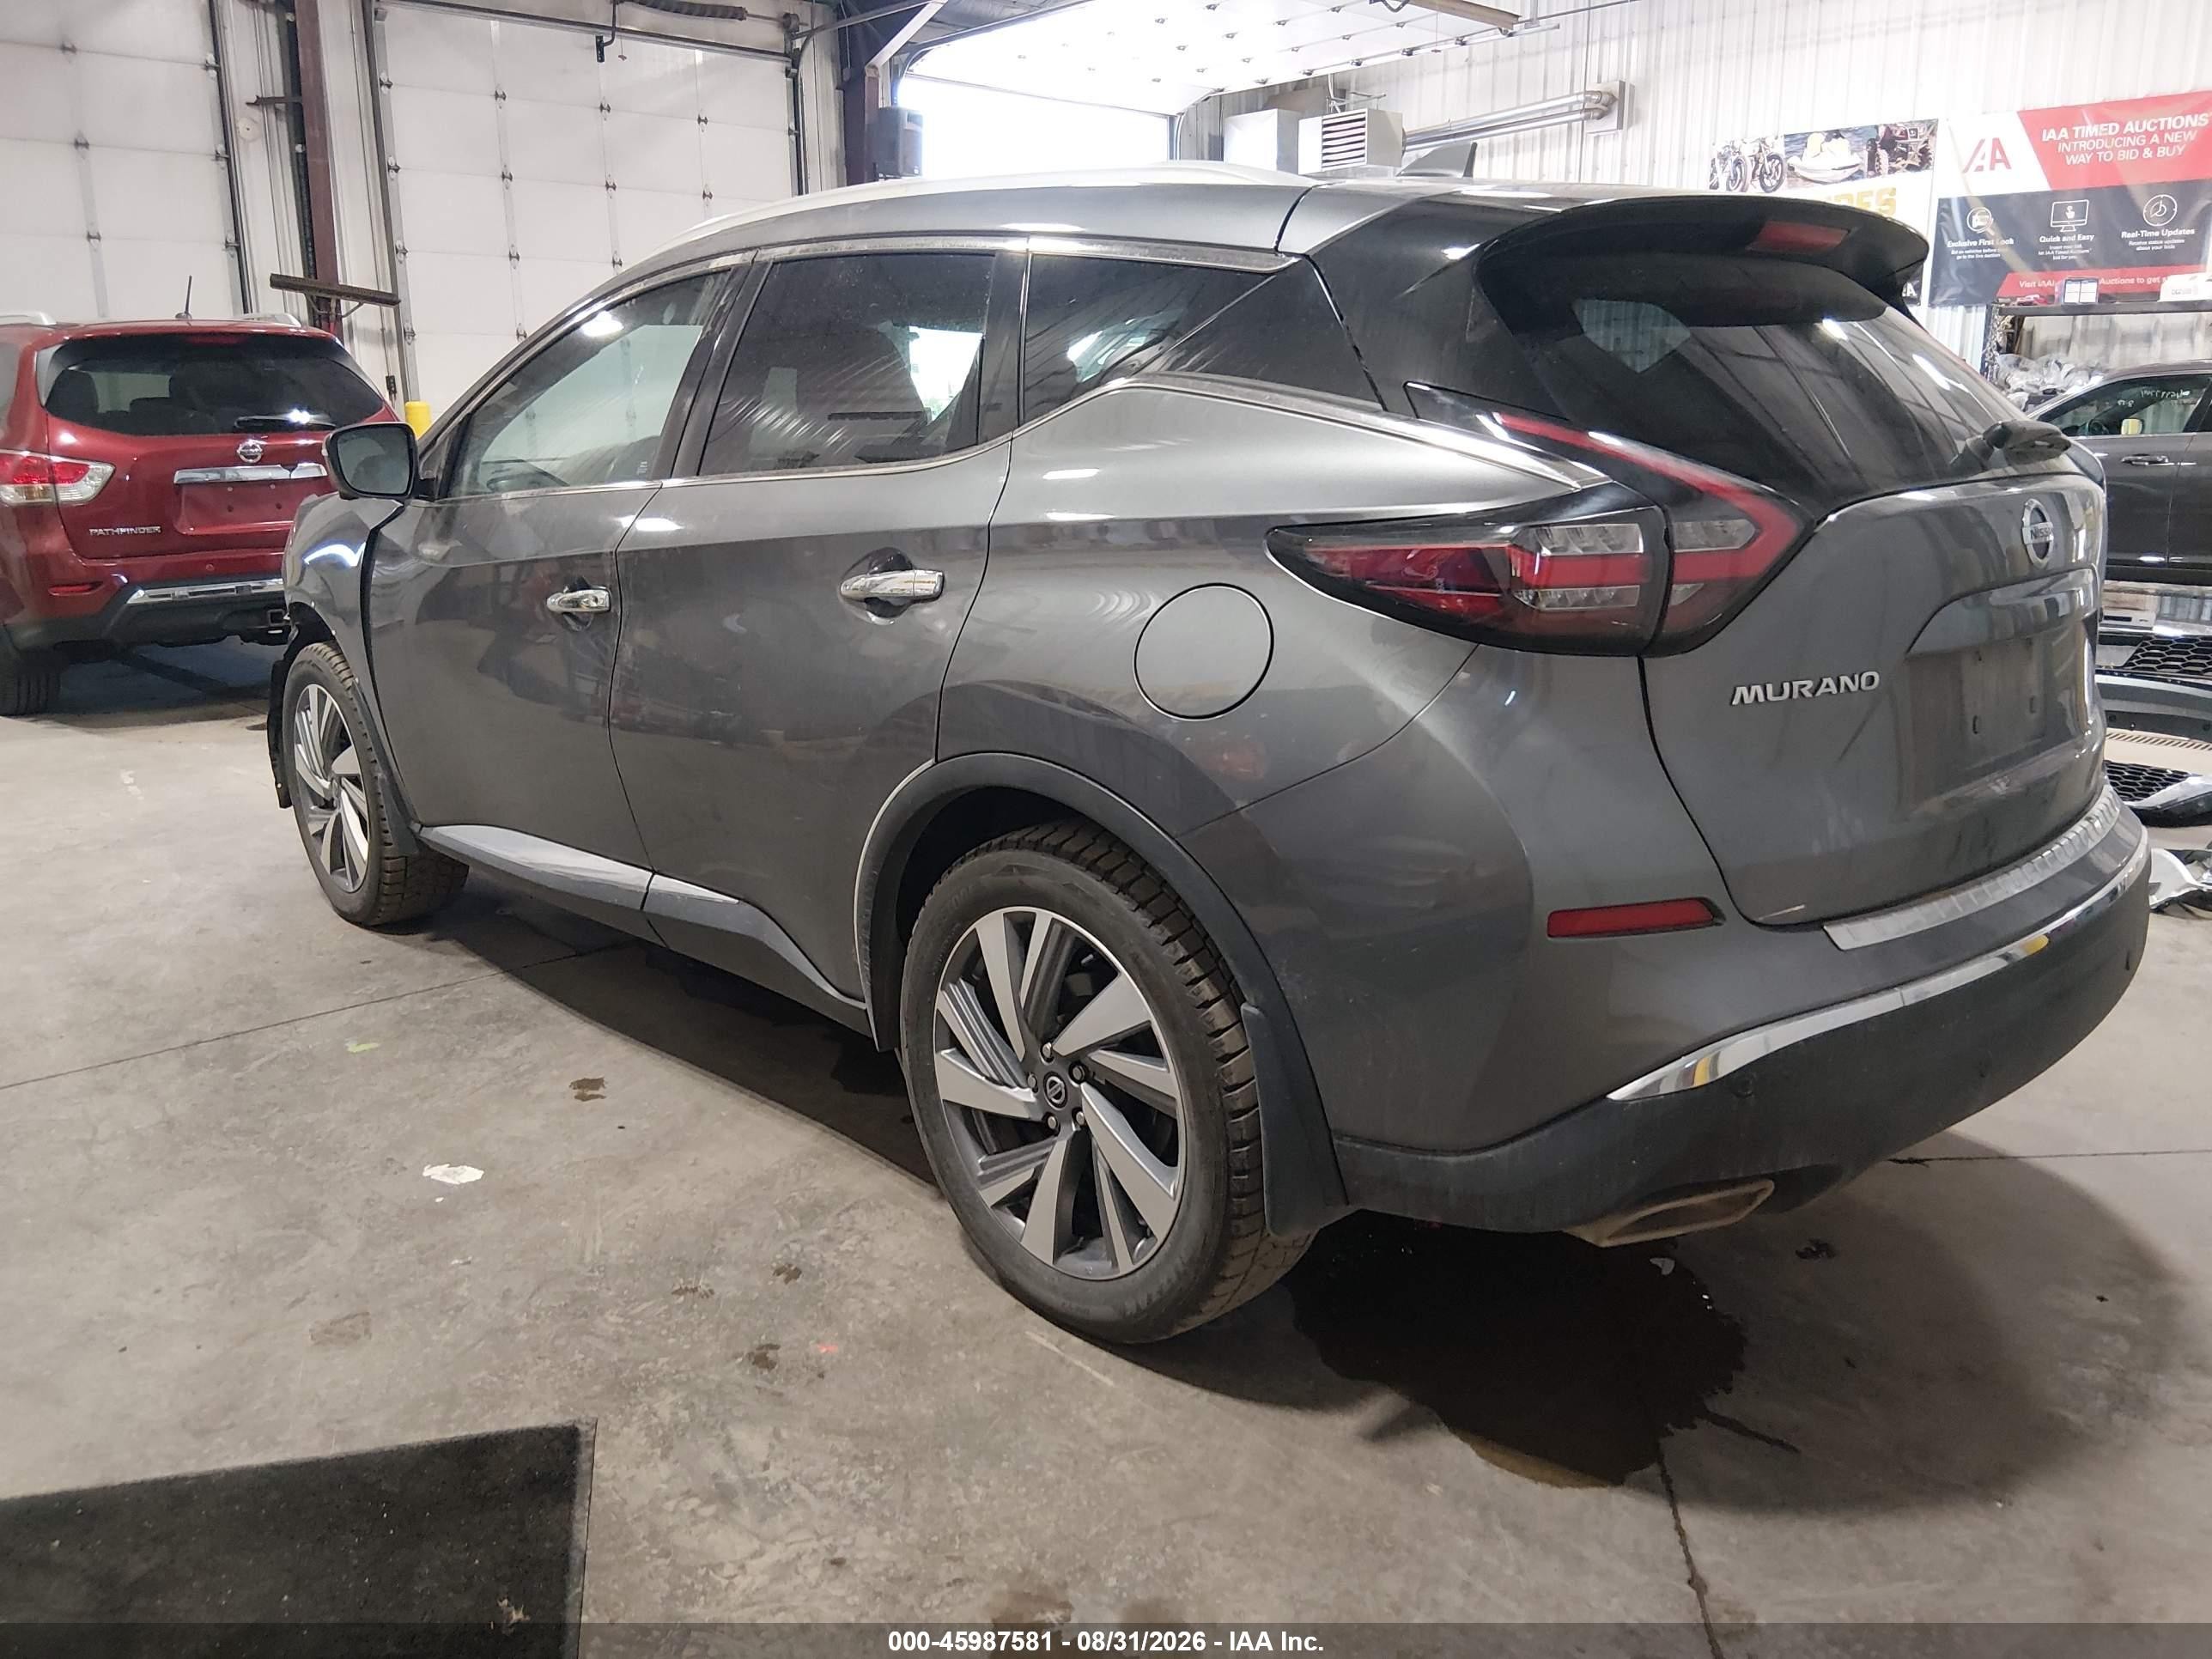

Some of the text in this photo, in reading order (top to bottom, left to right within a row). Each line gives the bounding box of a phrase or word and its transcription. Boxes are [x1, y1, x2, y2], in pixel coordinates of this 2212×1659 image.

[2042, 113, 2209, 142] IAA TIMED AUCTIONS
[2057, 130, 2197, 153] INTRODUCING A NEW
[2065, 144, 2186, 165] WAY TO BID & BUY
[2039, 234, 2061, 243] Quick
[2077, 233, 2095, 241] Easy
[2121, 228, 2195, 239] Real-Time Updates
[1947, 238, 1978, 247] Exclusive
[1978, 238, 1994, 246] First
[2019, 280, 2036, 289] Visit
[2100, 276, 2135, 285] Auctions
[2147, 276, 2160, 284] get
[88, 526, 161, 537] PATHFINDER
[1731, 671, 1881, 706] MURANO
